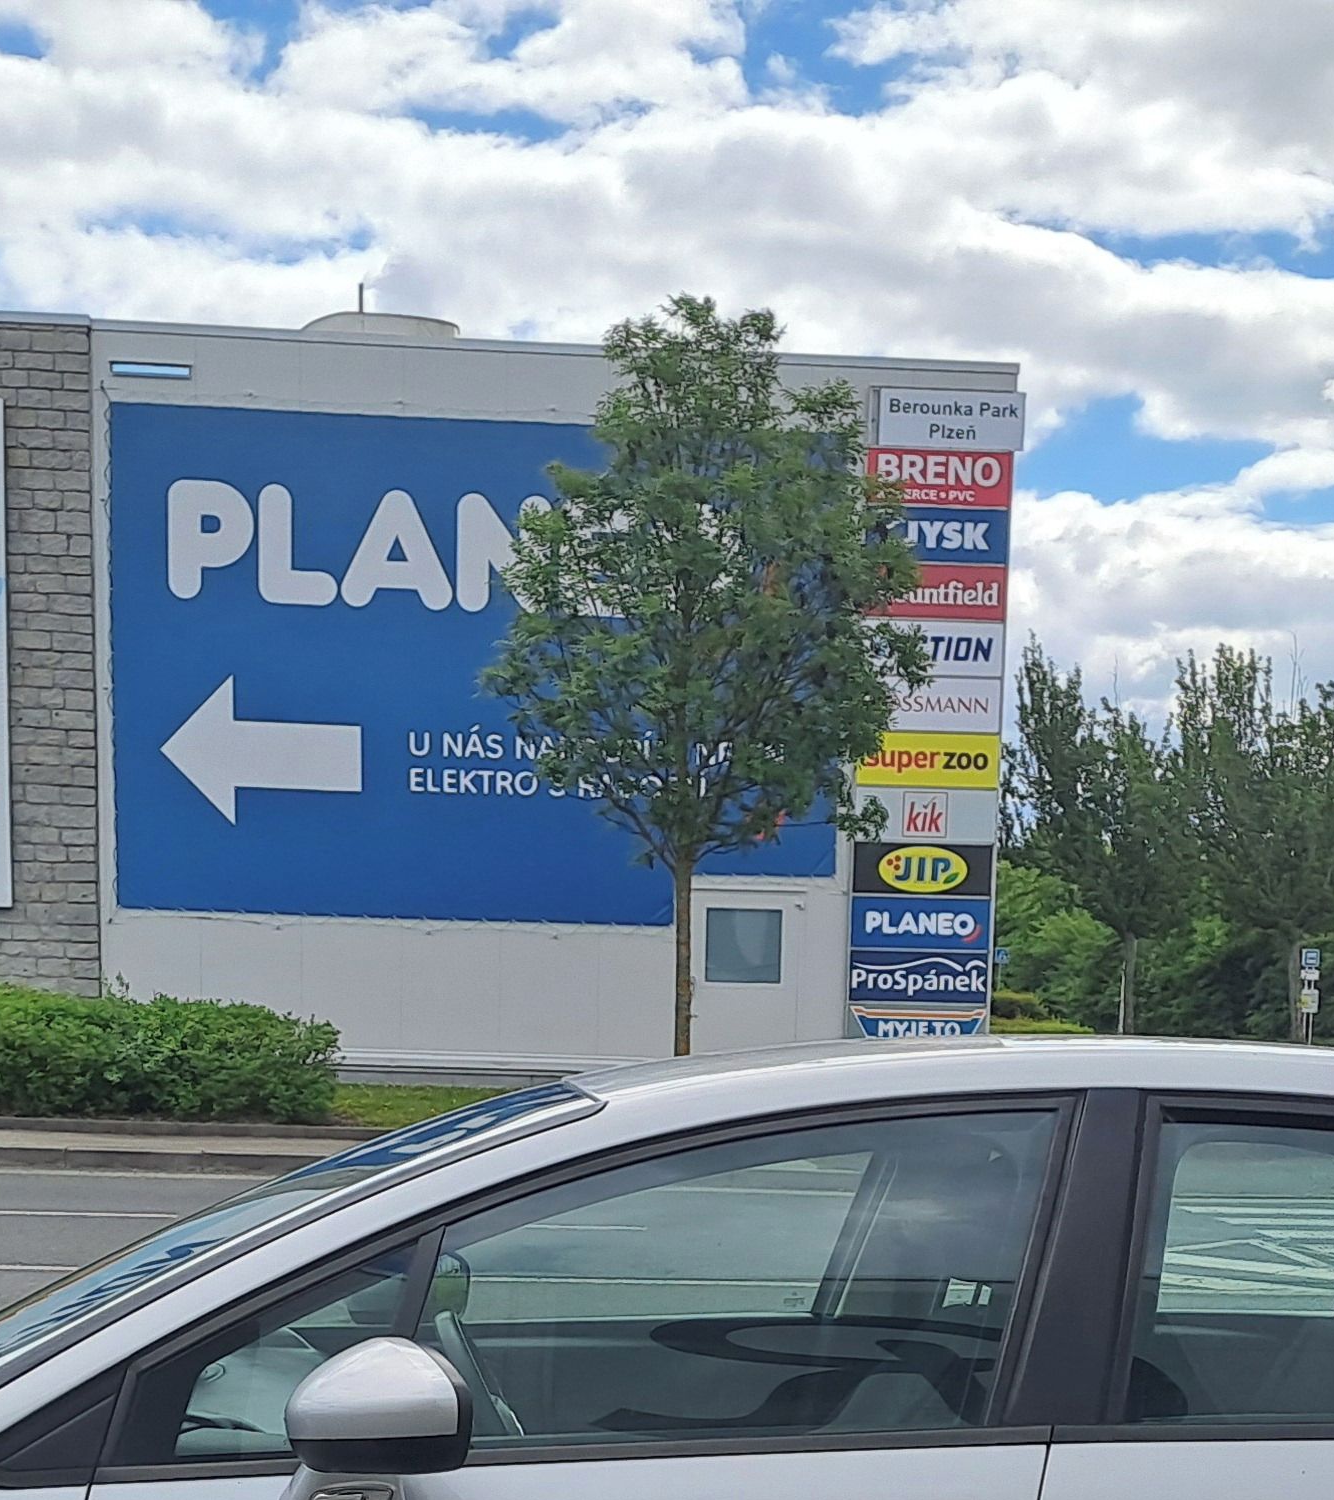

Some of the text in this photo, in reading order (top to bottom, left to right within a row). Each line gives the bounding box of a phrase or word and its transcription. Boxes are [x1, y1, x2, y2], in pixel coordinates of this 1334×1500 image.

[889, 398, 1019, 419] Berounka Park
[929, 423, 976, 441] Plzeň
[877, 453, 1002, 488] BRENO
[948, 489, 976, 502] PVC
[905, 519, 990, 551] JYSK
[917, 635, 993, 662] TION
[408, 732, 430, 757] U
[442, 723, 504, 760] NÁS
[408, 767, 539, 797] ELEKTRO
[894, 856, 951, 881] JIP
[865, 910, 975, 936] PLANEO
[851, 968, 986, 996] ProSpánek
